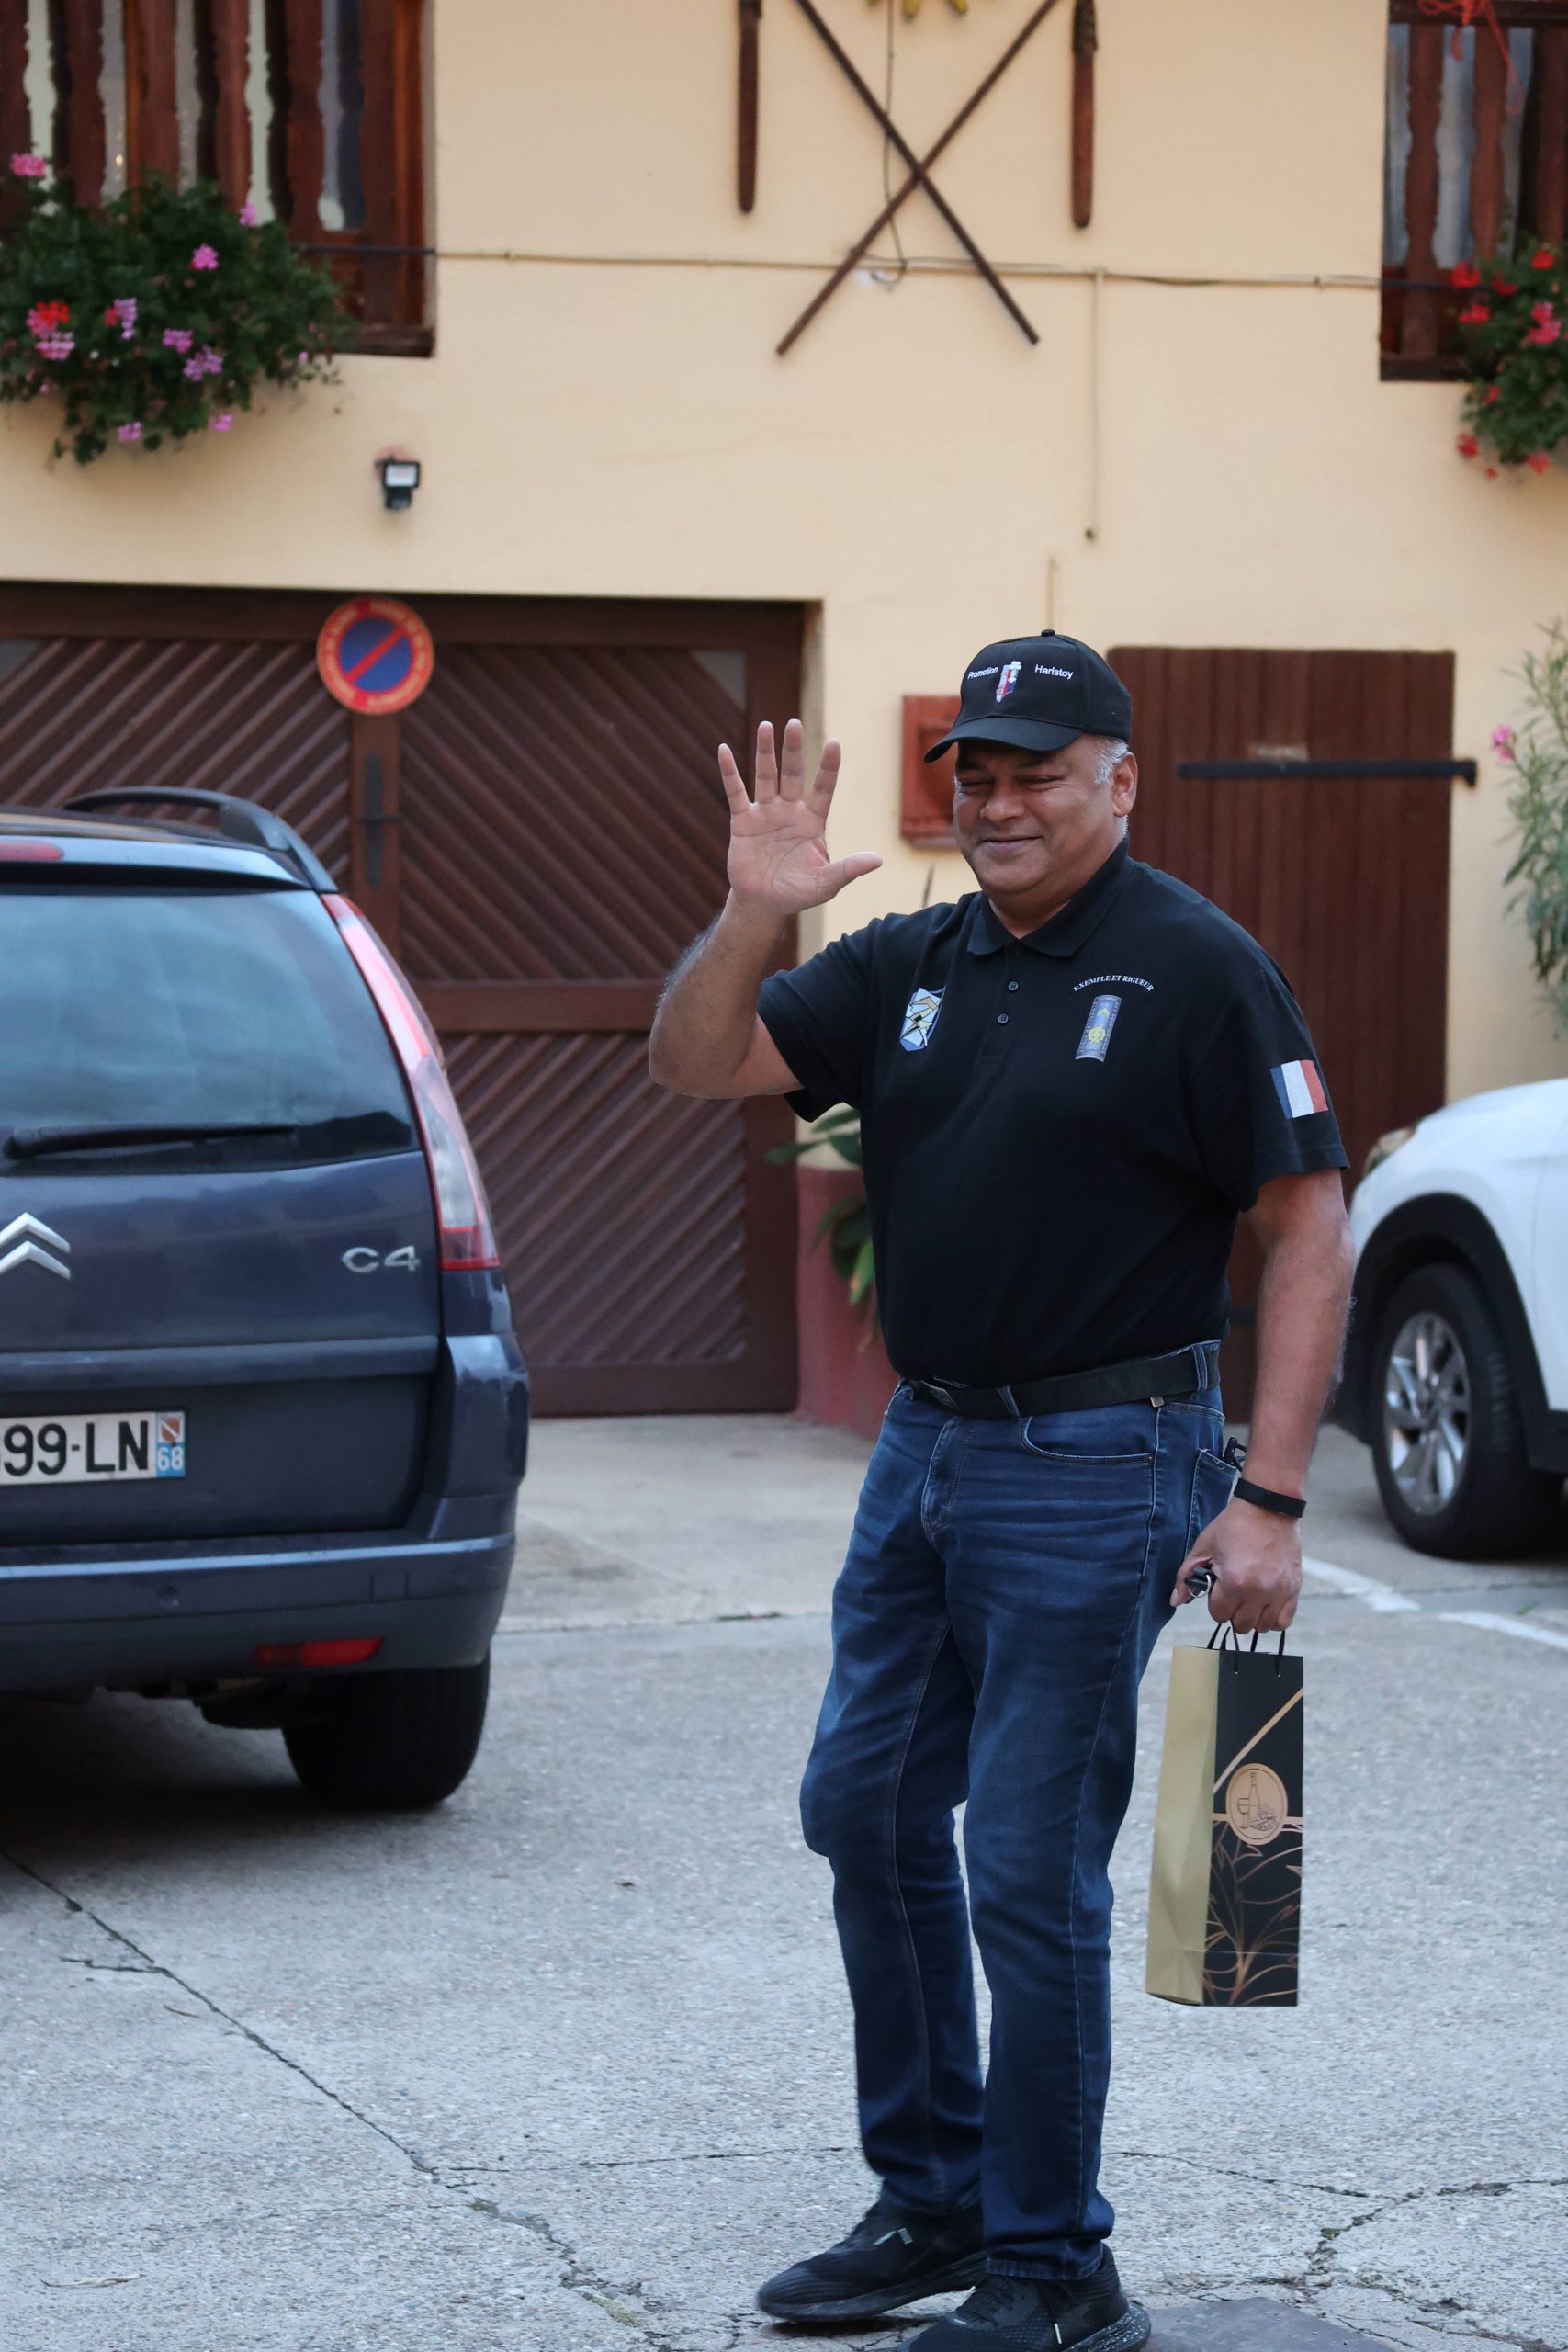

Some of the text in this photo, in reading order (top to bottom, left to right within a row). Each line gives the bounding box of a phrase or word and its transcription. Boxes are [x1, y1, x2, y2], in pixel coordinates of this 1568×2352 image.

[1074, 975, 1111, 991] EXEMPLE
[1122, 975, 1154, 991] RIGUEUR
[341, 1245, 421, 1273] C4
[157, 1446, 185, 1471] 68
